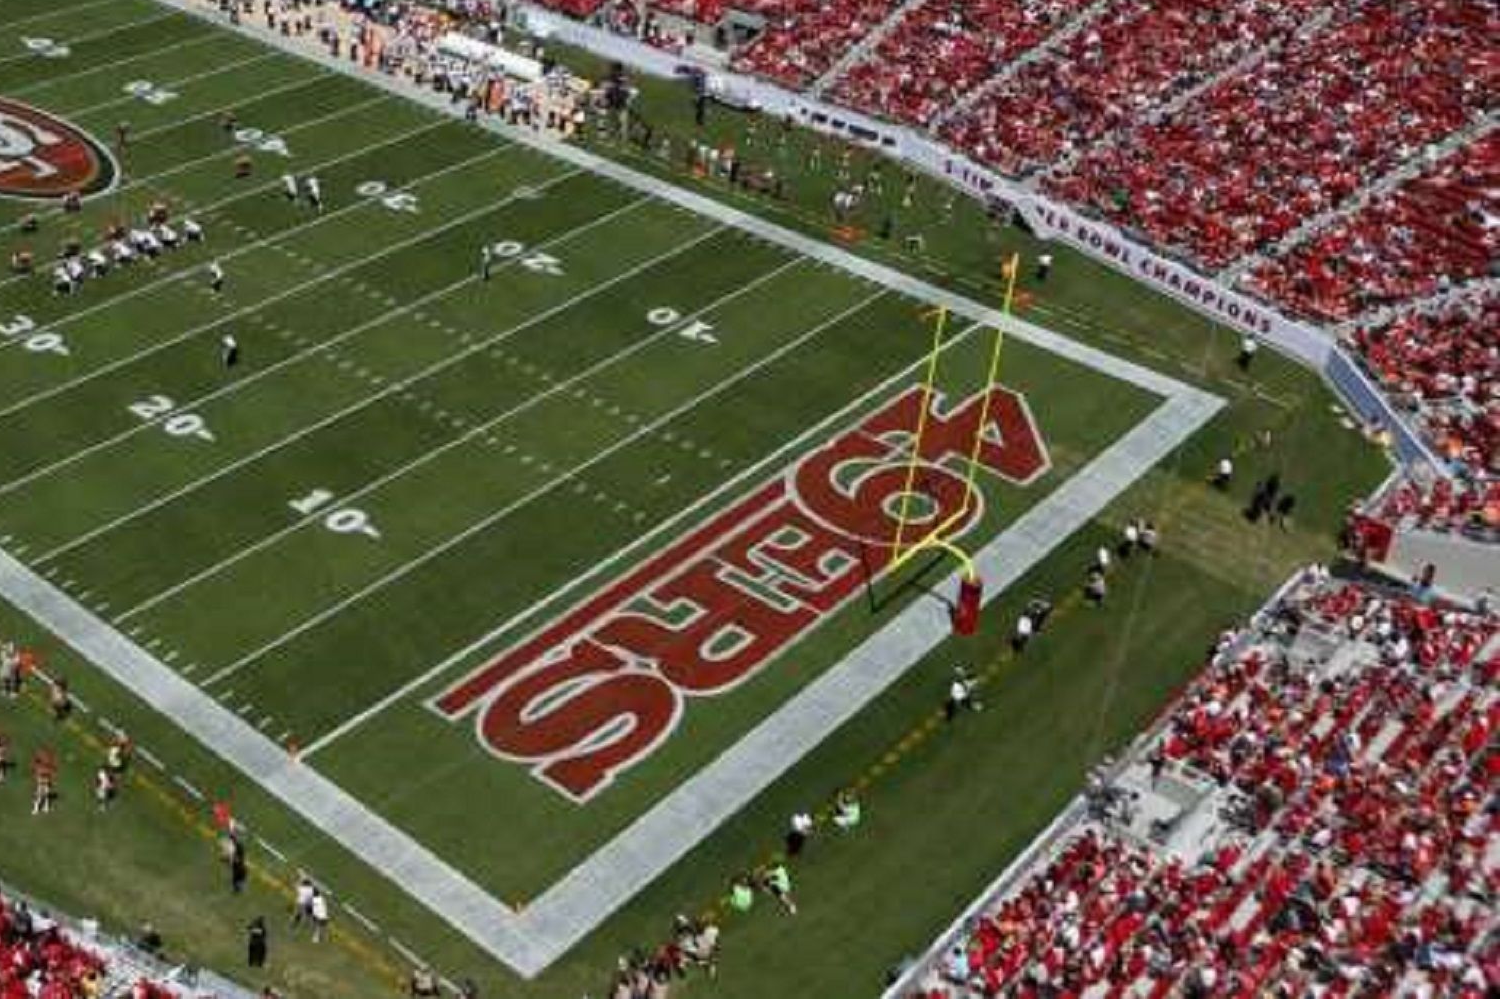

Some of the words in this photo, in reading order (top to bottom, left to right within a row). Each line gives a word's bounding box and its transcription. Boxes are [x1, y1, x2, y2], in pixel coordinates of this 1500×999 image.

[1077, 226, 1132, 263] BOWL
[1139, 257, 1273, 334] CHAMPIONS
[129, 394, 202, 437] 20
[288, 487, 367, 535] 10
[427, 382, 1053, 804] 49ERS
